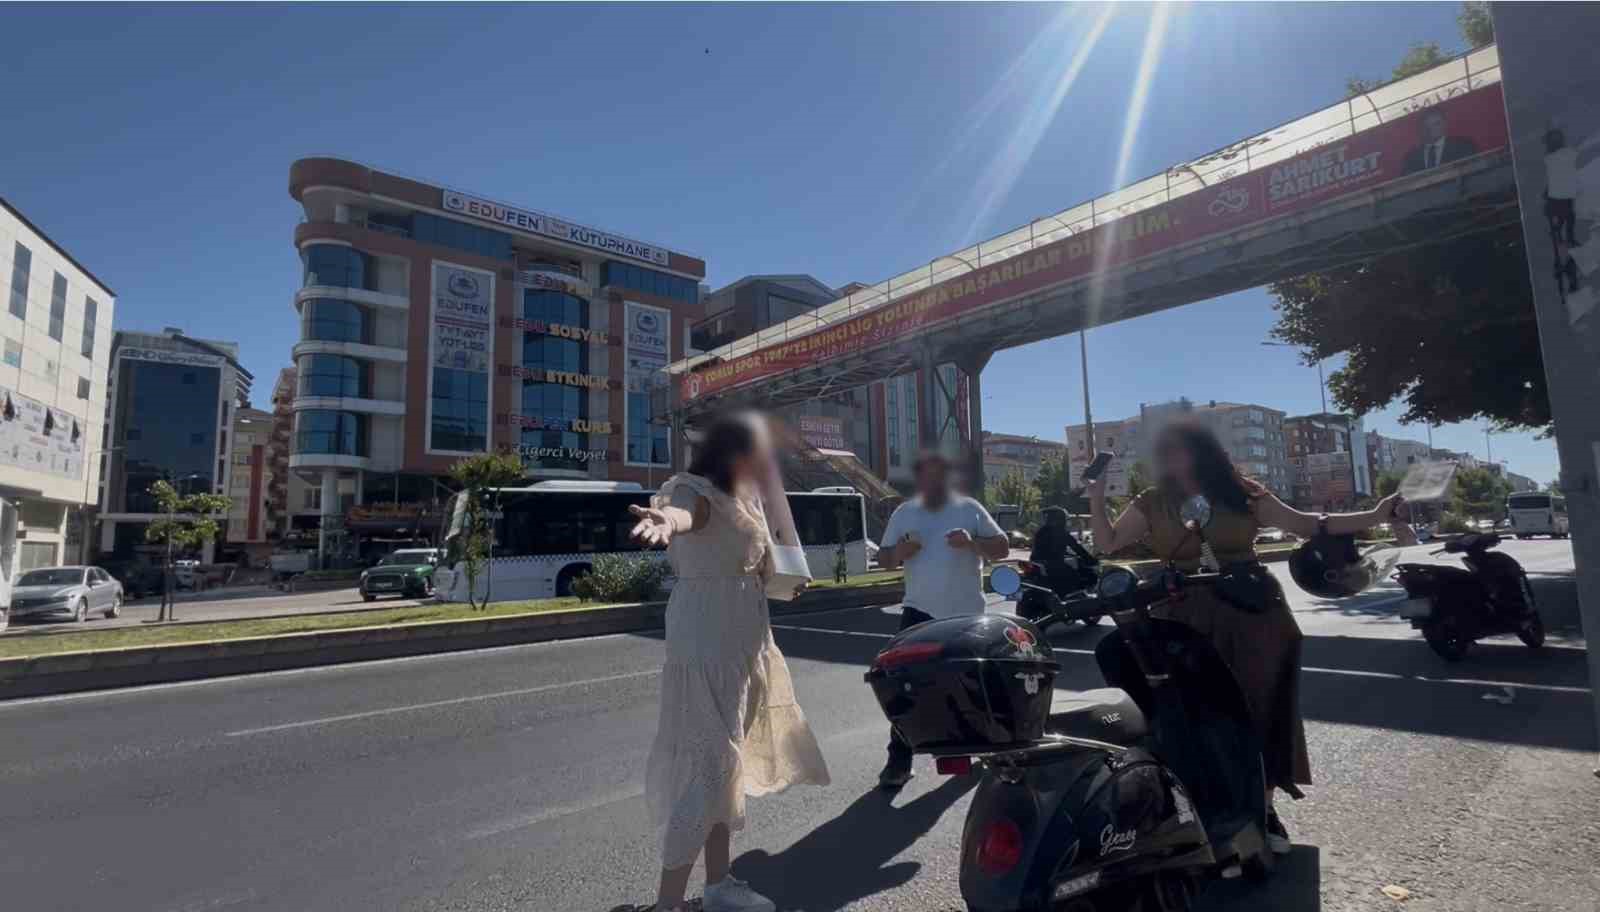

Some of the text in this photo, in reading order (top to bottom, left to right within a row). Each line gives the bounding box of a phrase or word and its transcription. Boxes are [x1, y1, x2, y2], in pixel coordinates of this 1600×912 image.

[1271, 147, 1346, 184] AHMET
[468, 201, 541, 231] EDUFEN
[569, 226, 651, 260] KÜTÜPHANE
